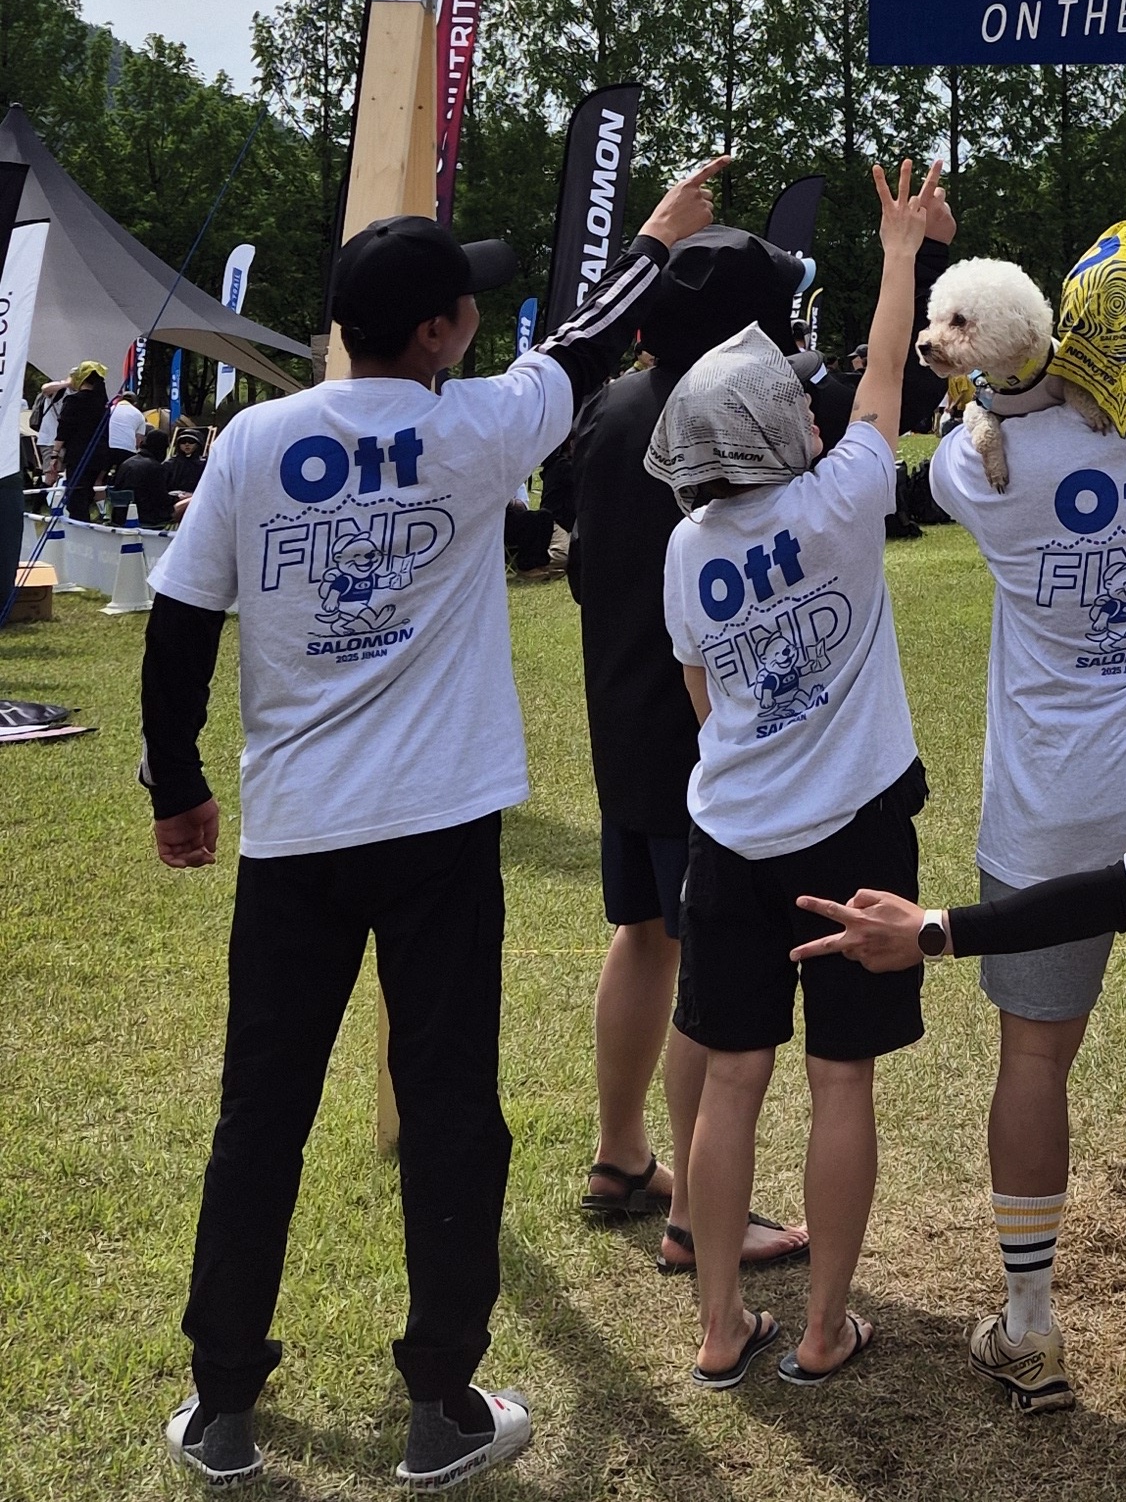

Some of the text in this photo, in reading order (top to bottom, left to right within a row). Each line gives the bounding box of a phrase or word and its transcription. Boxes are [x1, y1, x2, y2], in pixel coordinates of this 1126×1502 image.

[981, 0, 1042, 42] ON
[280, 427, 424, 504] Ott
[261, 507, 456, 591] FIND
[699, 529, 805, 623] Ott
[306, 627, 414, 655] SALOMON
[336, 649, 388, 664] 2025 JINAN
[1101, 666, 1122, 676] 2025
